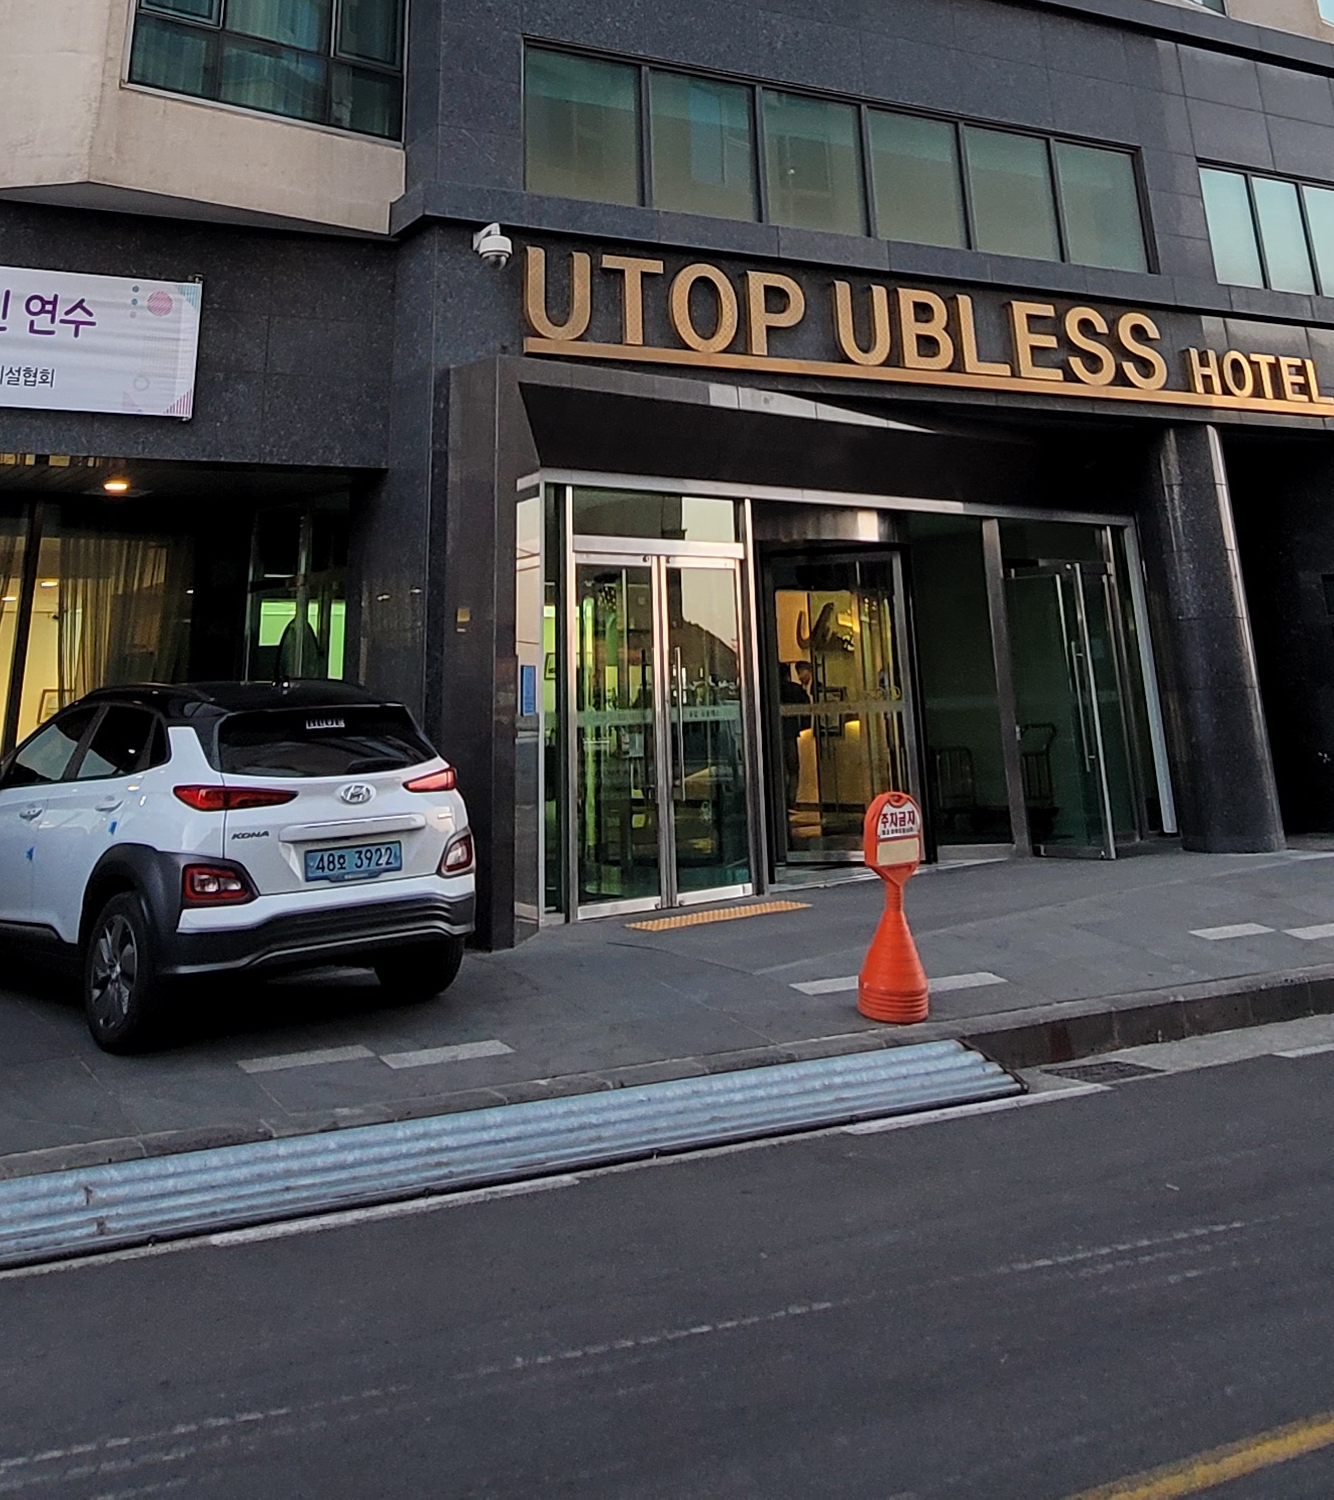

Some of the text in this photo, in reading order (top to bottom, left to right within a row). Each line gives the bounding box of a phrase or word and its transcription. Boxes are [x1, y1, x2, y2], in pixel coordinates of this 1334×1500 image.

[24, 293, 97, 339] 연수
[525, 245, 806, 356] UTOP
[832, 279, 1168, 391] UBLESS
[881, 810, 915, 828] 주차금지
[231, 830, 270, 840] KONA
[315, 846, 394, 873] 48호 3922
